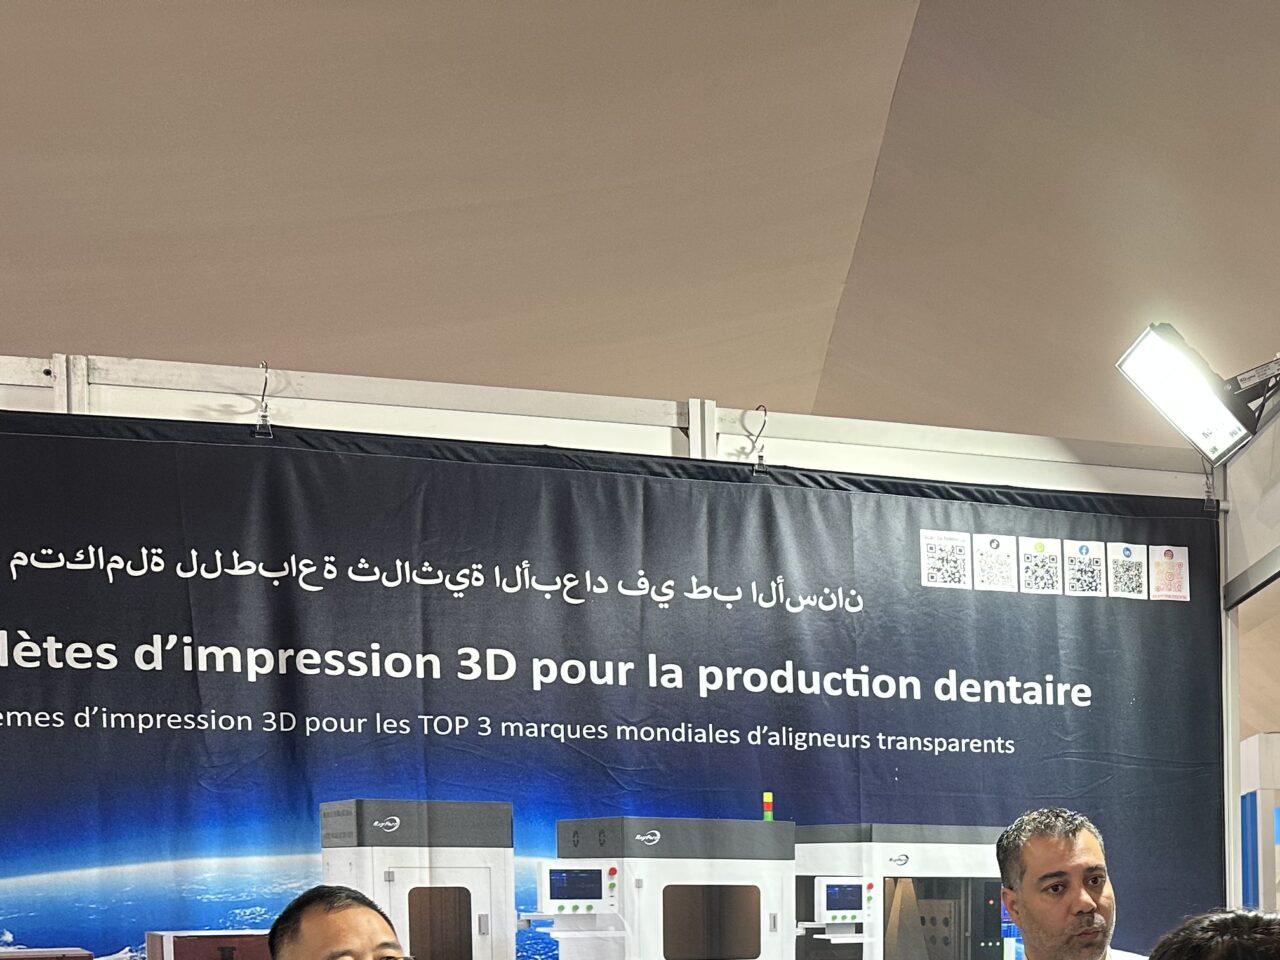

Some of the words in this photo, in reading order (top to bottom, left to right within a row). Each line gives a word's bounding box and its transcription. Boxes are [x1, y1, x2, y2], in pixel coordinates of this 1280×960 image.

[456, 646, 517, 681] 3D
[532, 657, 635, 691] pour
[648, 653, 683, 688] la
[699, 661, 921, 700] production
[934, 669, 1092, 707] dentaire
[262, 711, 297, 732] 3D
[305, 715, 368, 737] pour
[375, 713, 411, 734] les
[418, 715, 469, 736] TOP
[477, 716, 492, 737] 3
[501, 721, 608, 743] marques
[616, 722, 741, 745] mondiales
[877, 732, 1015, 756] transparents
